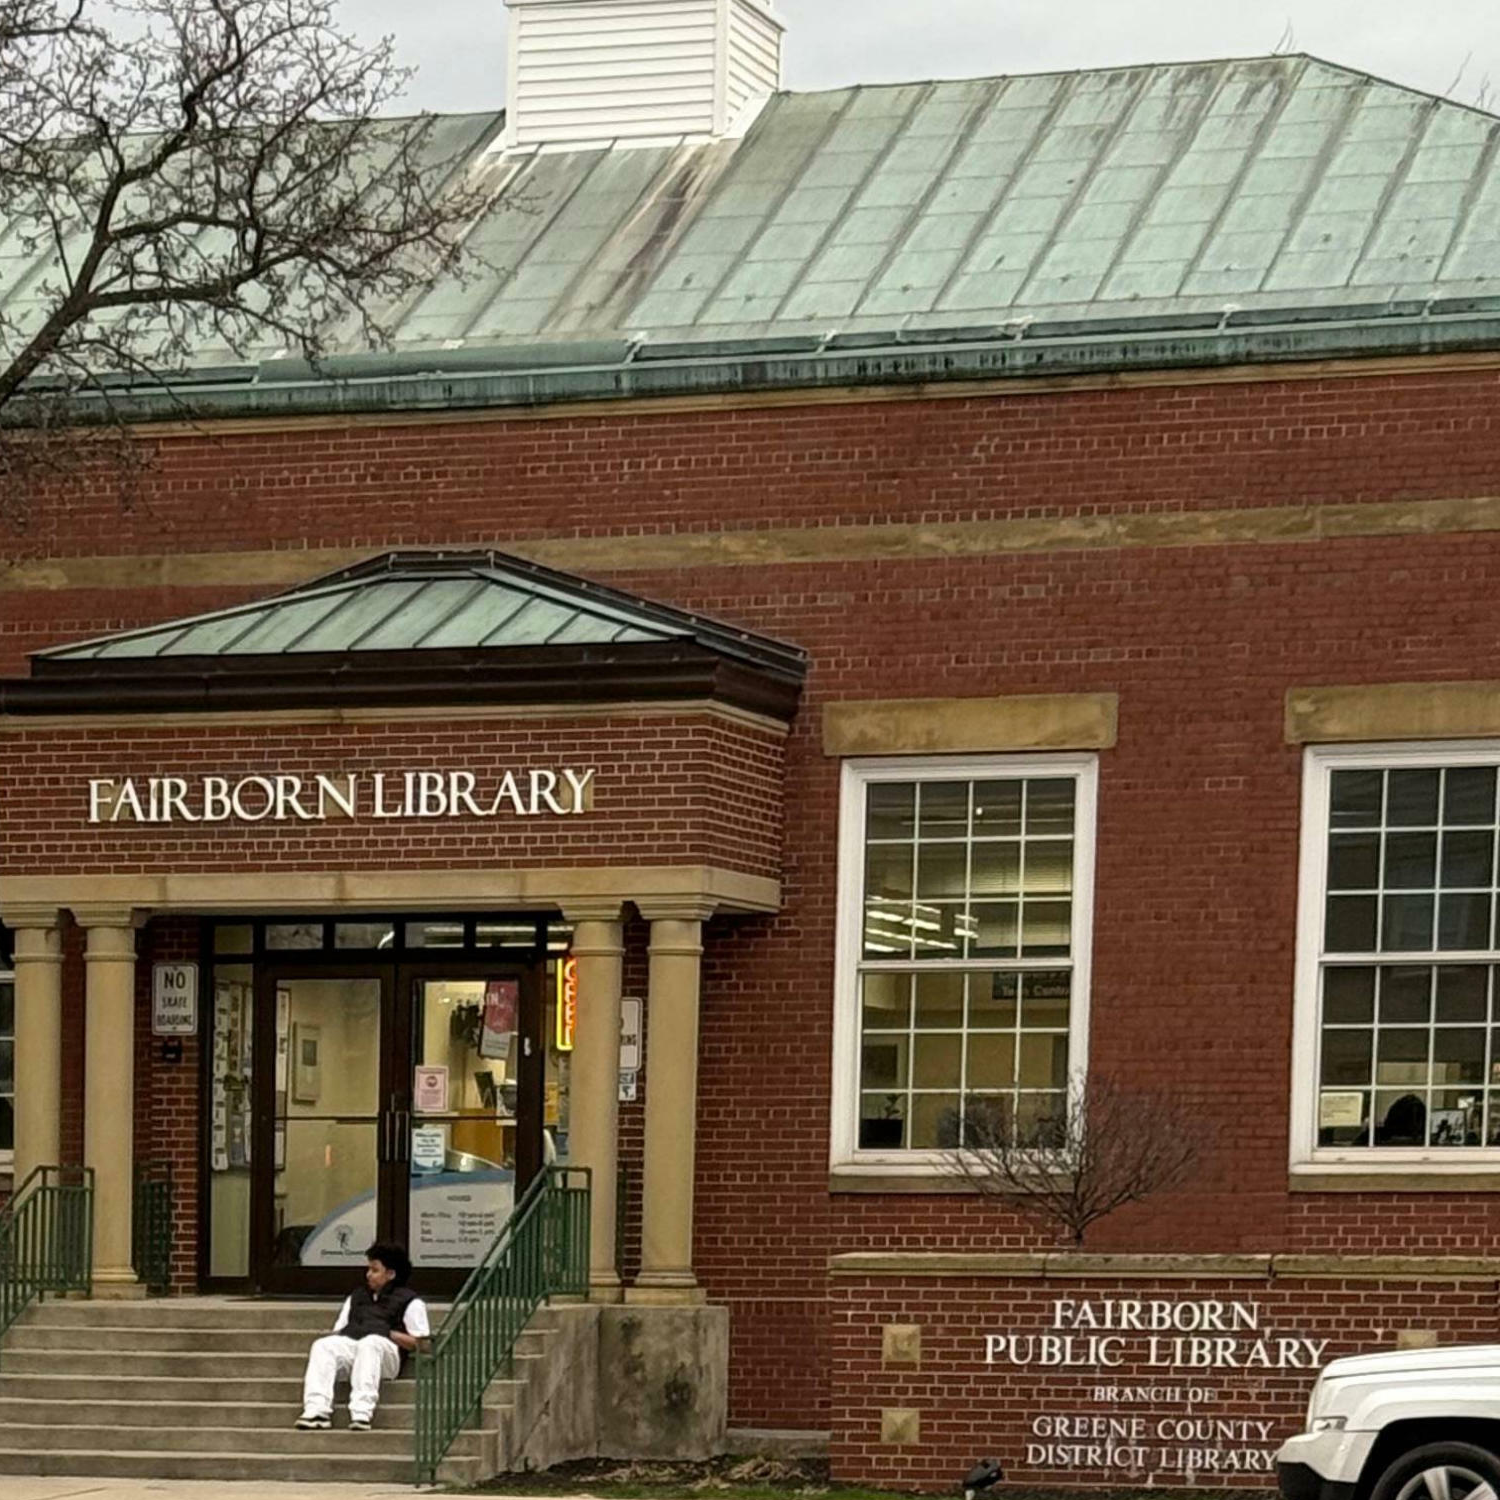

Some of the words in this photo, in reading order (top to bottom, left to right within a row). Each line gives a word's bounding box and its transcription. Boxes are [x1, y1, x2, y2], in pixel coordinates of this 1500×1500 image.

[87, 774, 357, 823] FAIRBORN
[372, 768, 596, 818] LIBRARY
[164, 971, 186, 989] NO
[1053, 1300, 1260, 1331] FAIRBORN
[984, 1335, 1127, 1367] PUBLIC
[1149, 1338, 1330, 1368] LIBRARY
[1092, 1386, 1184, 1403] BRANCH
[1188, 1387, 1217, 1404] OF
[1032, 1416, 1146, 1439] GREENE
[1157, 1419, 1274, 1441] COUNTY
[1026, 1444, 1150, 1468] DISTRICT
[1160, 1448, 1279, 1472] LIBRARY
